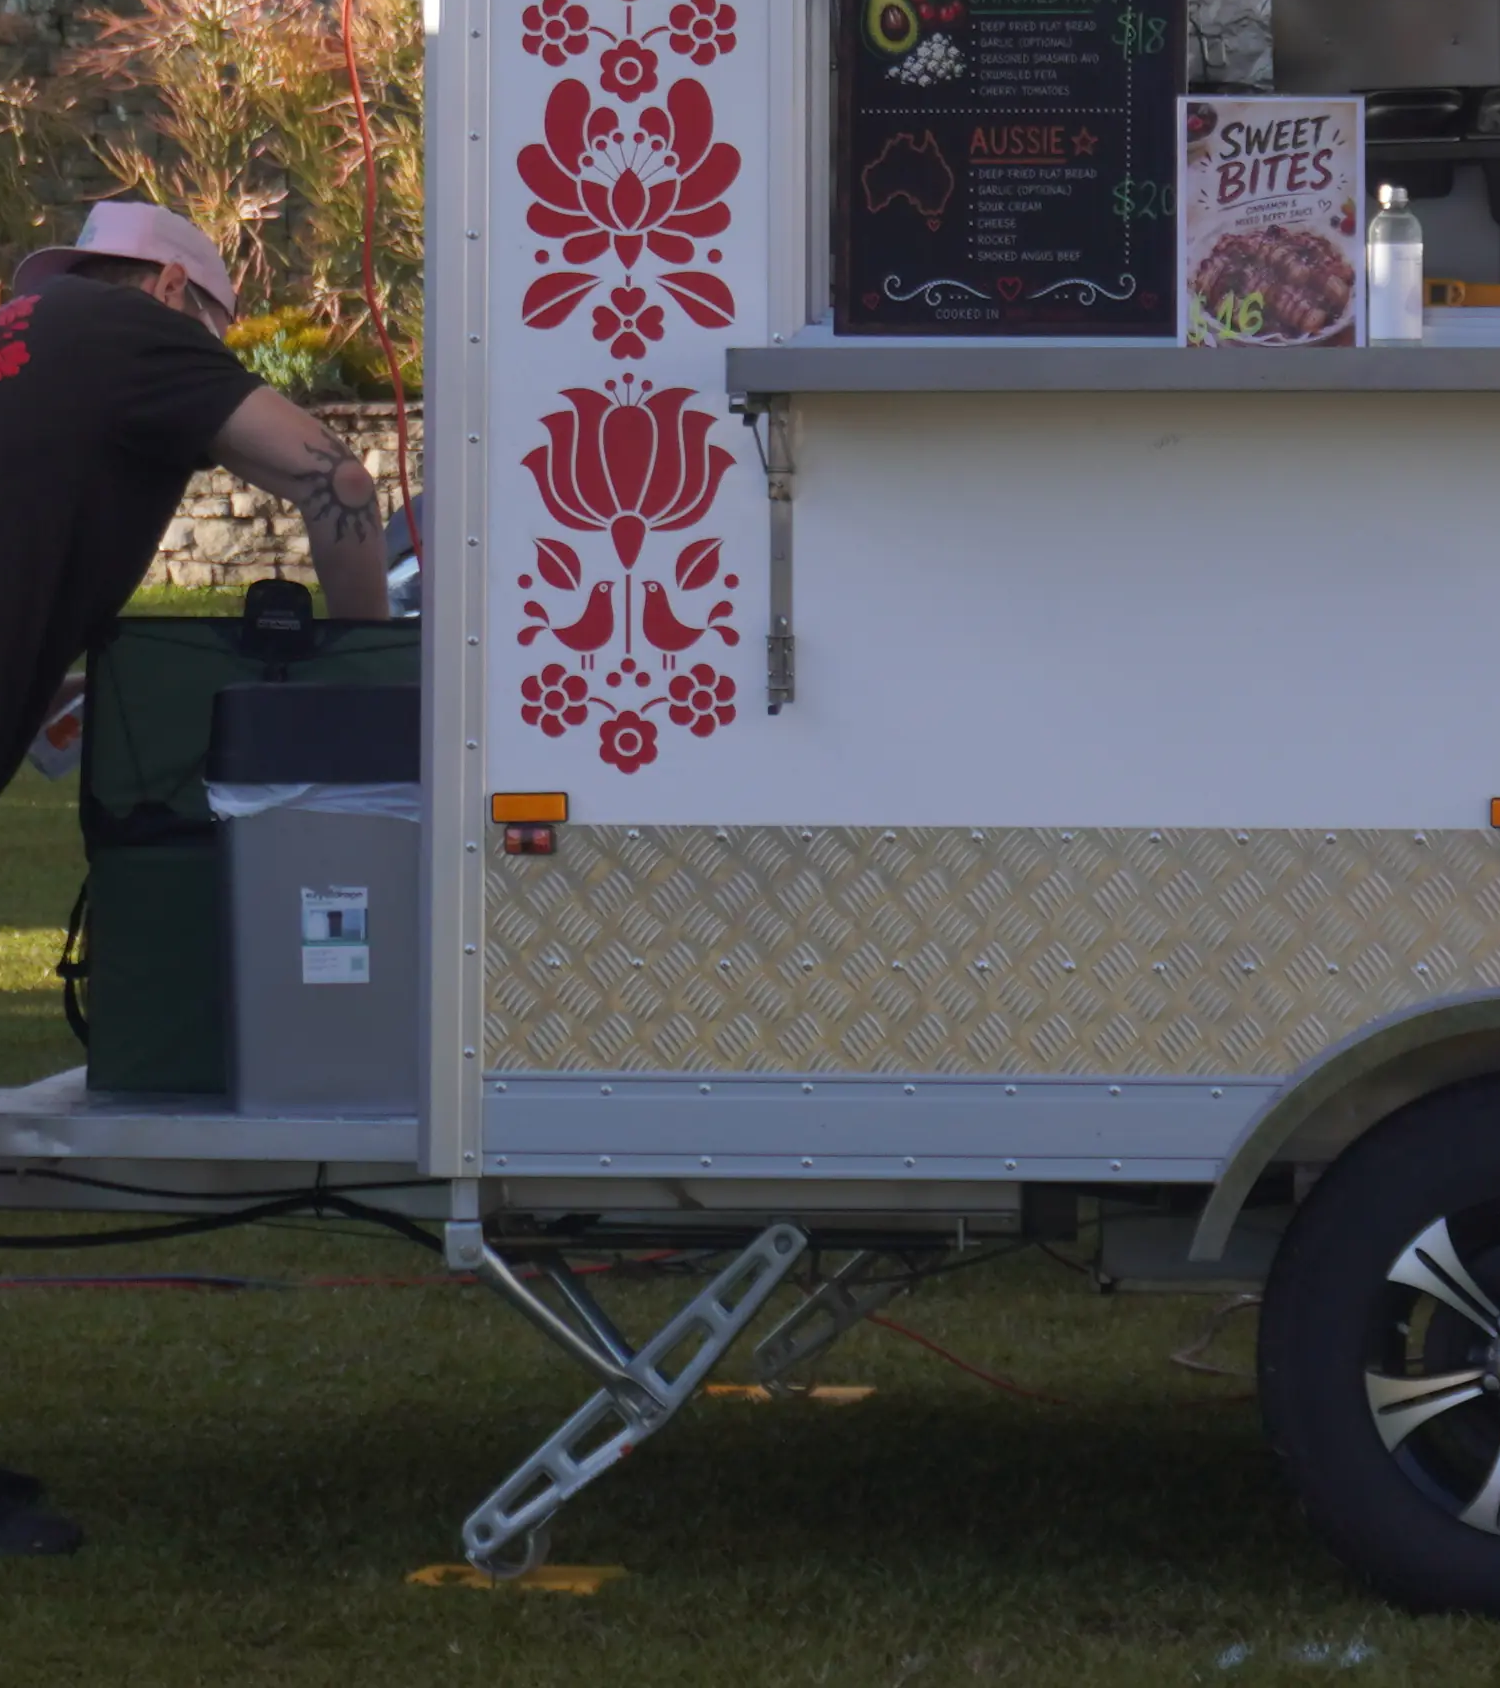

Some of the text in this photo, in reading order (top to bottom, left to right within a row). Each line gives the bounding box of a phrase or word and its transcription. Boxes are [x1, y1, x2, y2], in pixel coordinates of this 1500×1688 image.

[980, 21, 1007, 32] DEEP
[1112, 11, 1167, 59] $18
[979, 54, 1029, 65] SEASONED
[1080, 54, 1099, 64] AVO
[979, 86, 1069, 97] CHERRY TOMATOES
[970, 125, 1066, 156] AUSSIE
[1220, 114, 1330, 161] SWEET
[978, 169, 1004, 179] DEEP
[1064, 169, 1098, 179] BREAD
[1216, 148, 1333, 204] BITES
[1112, 179, 1176, 221] $20
[977, 202, 1042, 212] SOUR CREAM
[977, 218, 1016, 229] CHEESE
[977, 235, 1016, 246] ROCKET
[977, 251, 1081, 262] SMOKED ANGUS BEEF
[935, 309, 981, 320] COOKED
[986, 309, 999, 320] IN
